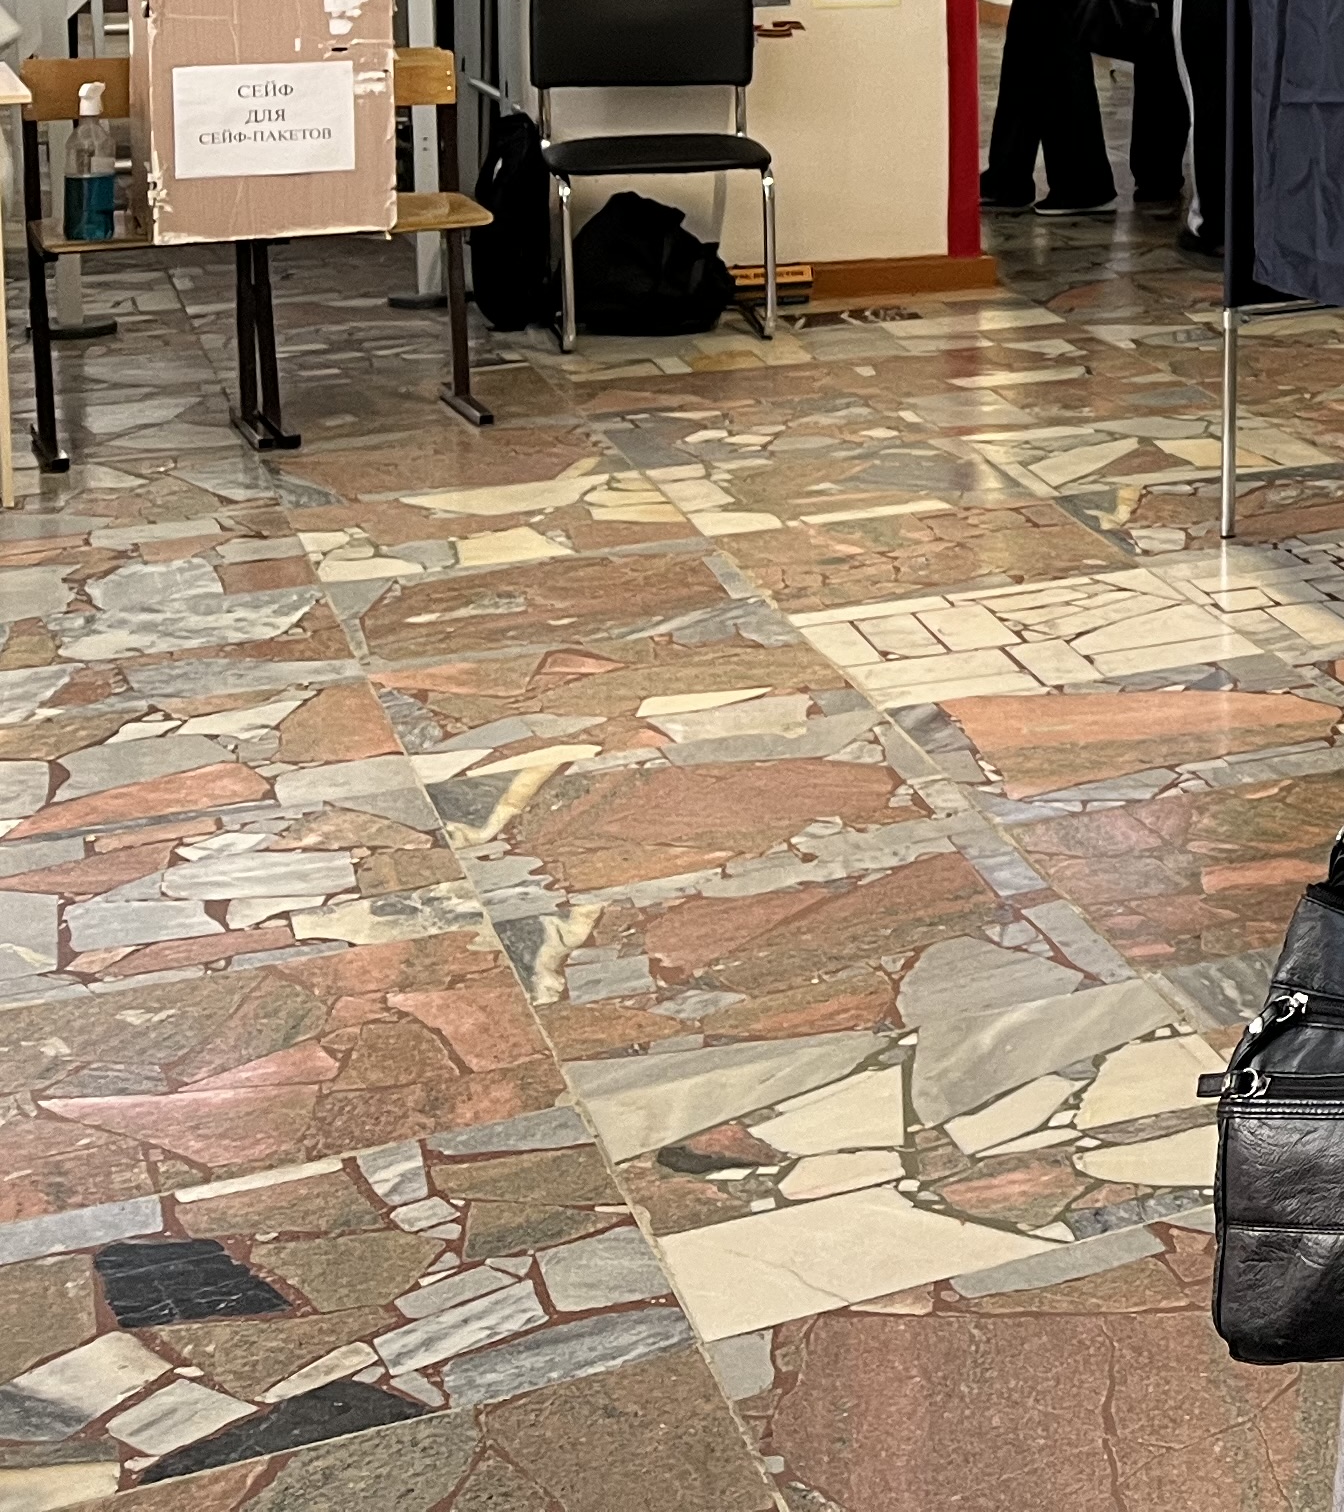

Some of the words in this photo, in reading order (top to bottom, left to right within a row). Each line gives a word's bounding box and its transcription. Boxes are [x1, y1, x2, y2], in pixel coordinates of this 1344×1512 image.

[237, 79, 294, 101] СЕЙФ
[244, 107, 286, 125] ДЛЯ
[198, 127, 333, 146] СЕЙФ-ПАКЕТОВ
